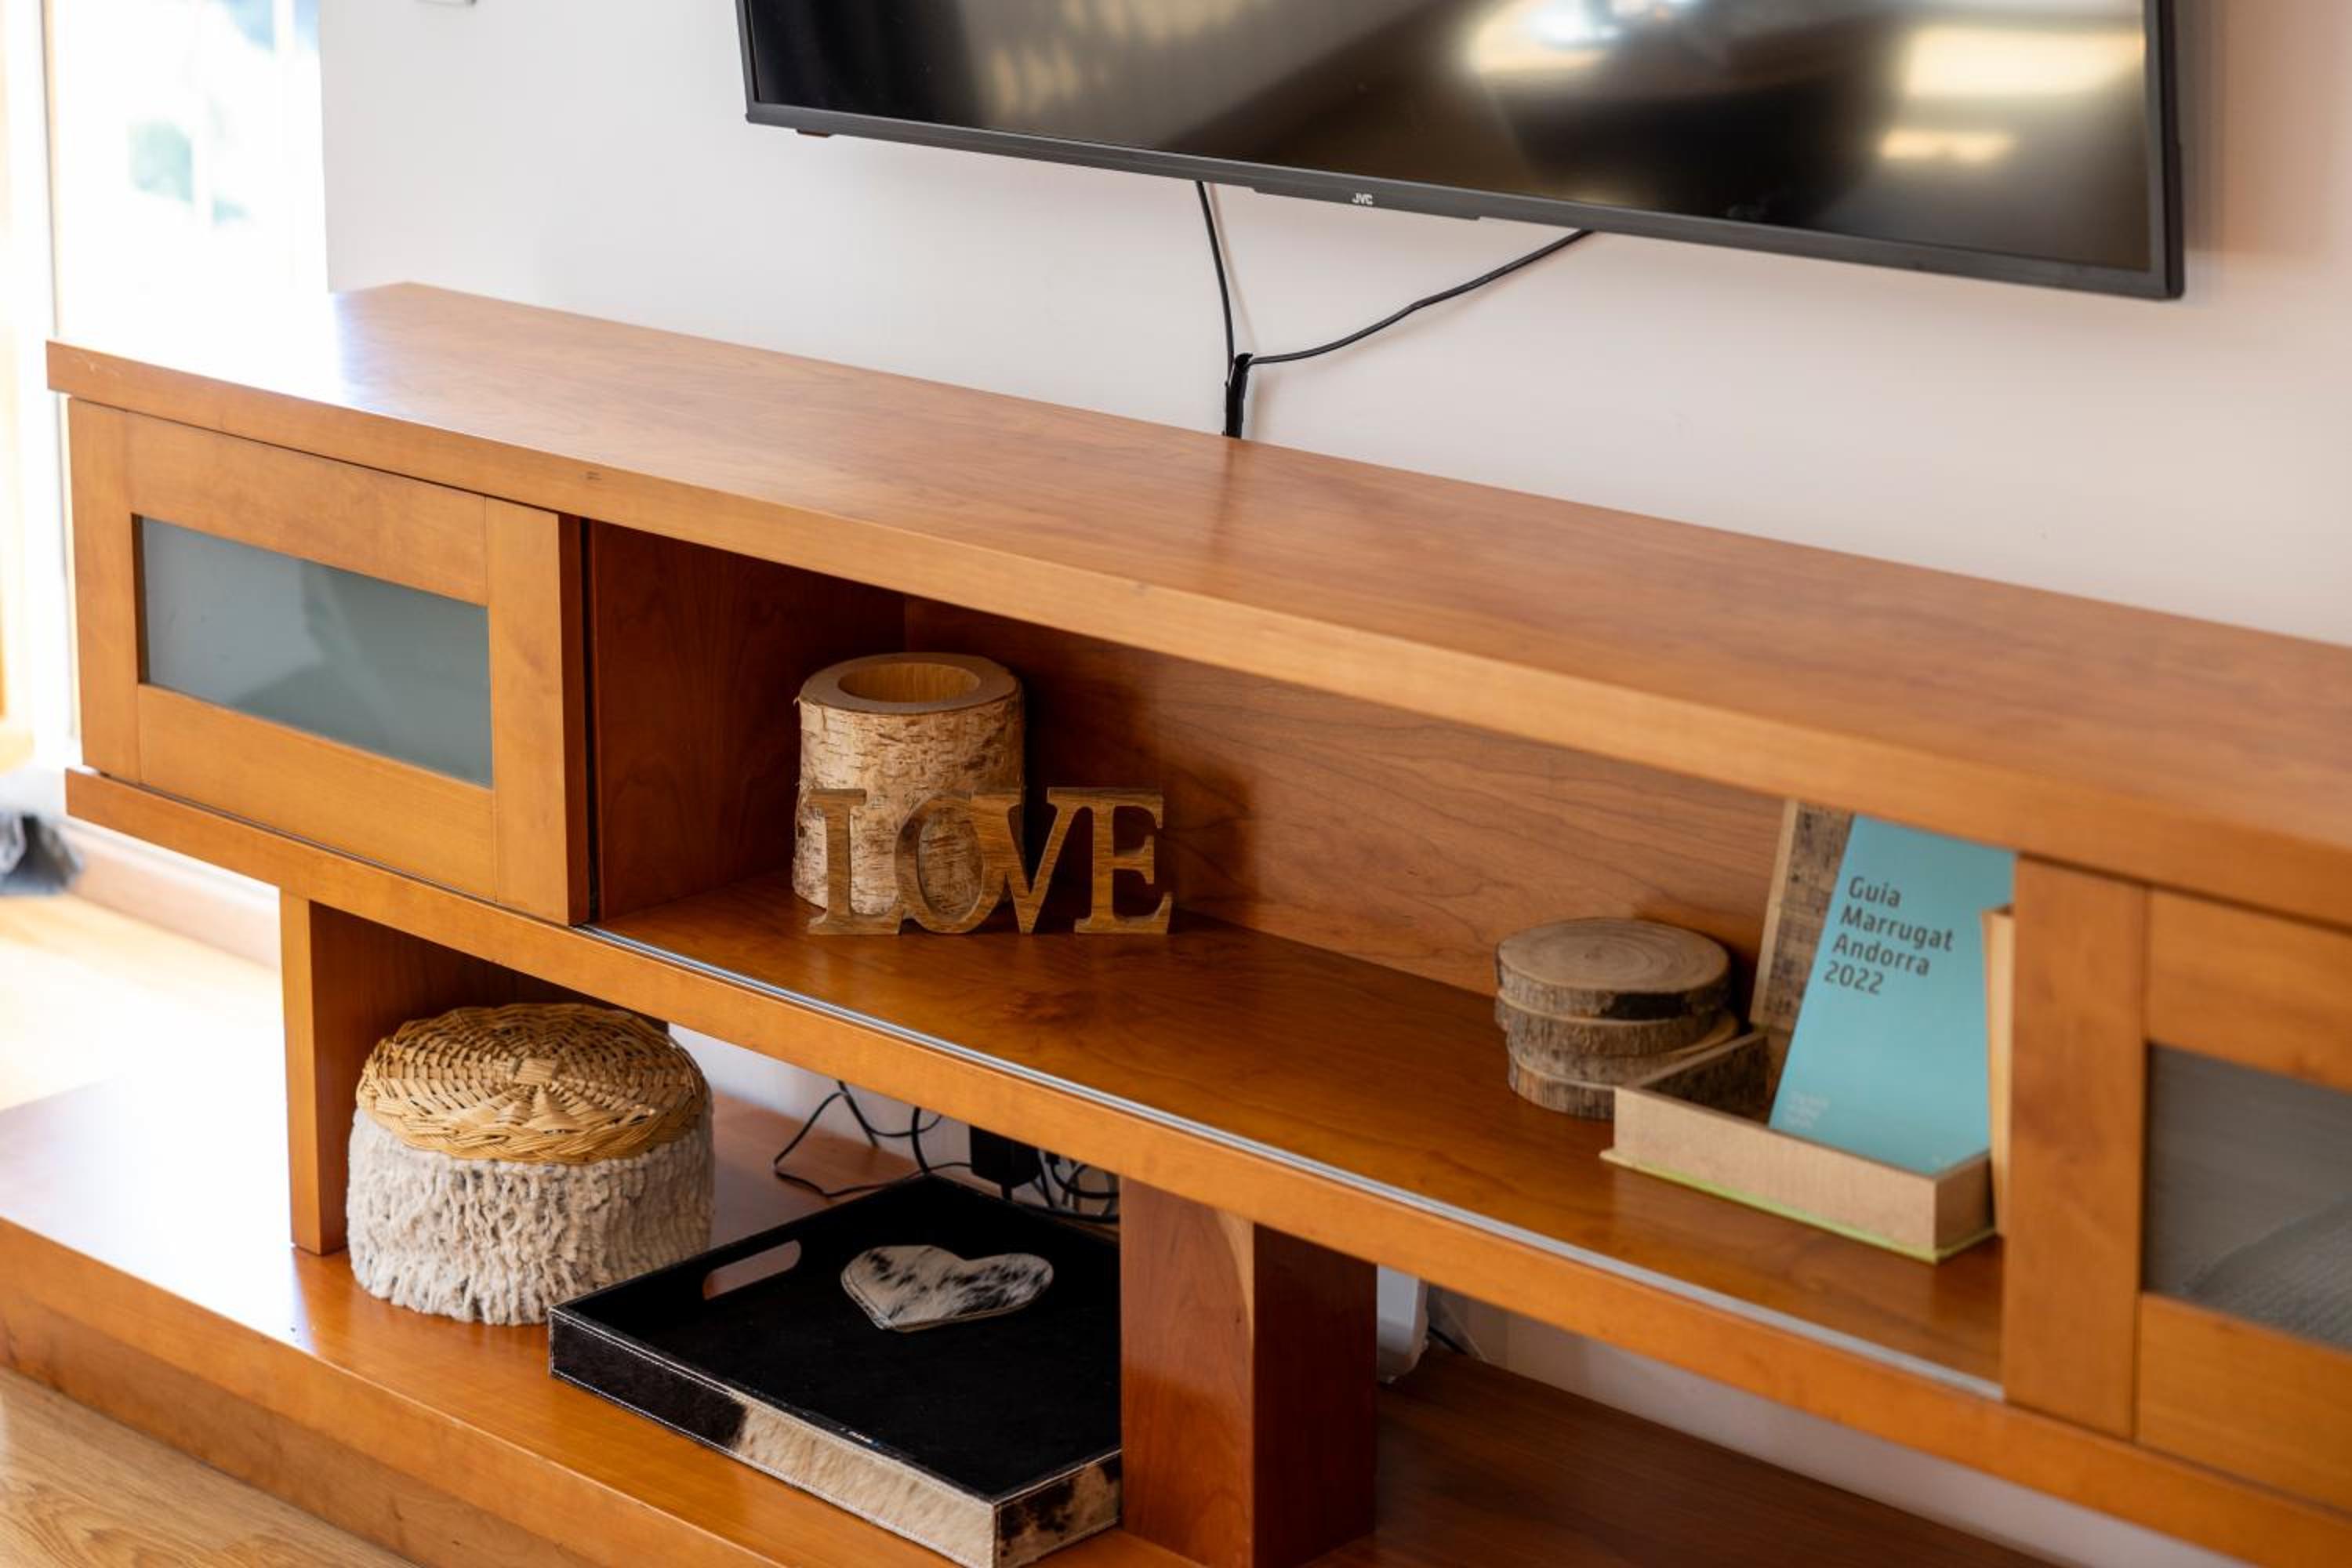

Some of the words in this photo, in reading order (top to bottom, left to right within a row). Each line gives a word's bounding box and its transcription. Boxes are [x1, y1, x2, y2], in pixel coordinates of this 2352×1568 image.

[1352, 192, 1374, 205] JVC
[807, 786, 1172, 935] LOVE
[1849, 876, 1901, 908] Guia
[1840, 904, 1953, 952] Marrugat
[1831, 932, 1930, 976] Andorra
[1824, 960, 1884, 995] 2022
